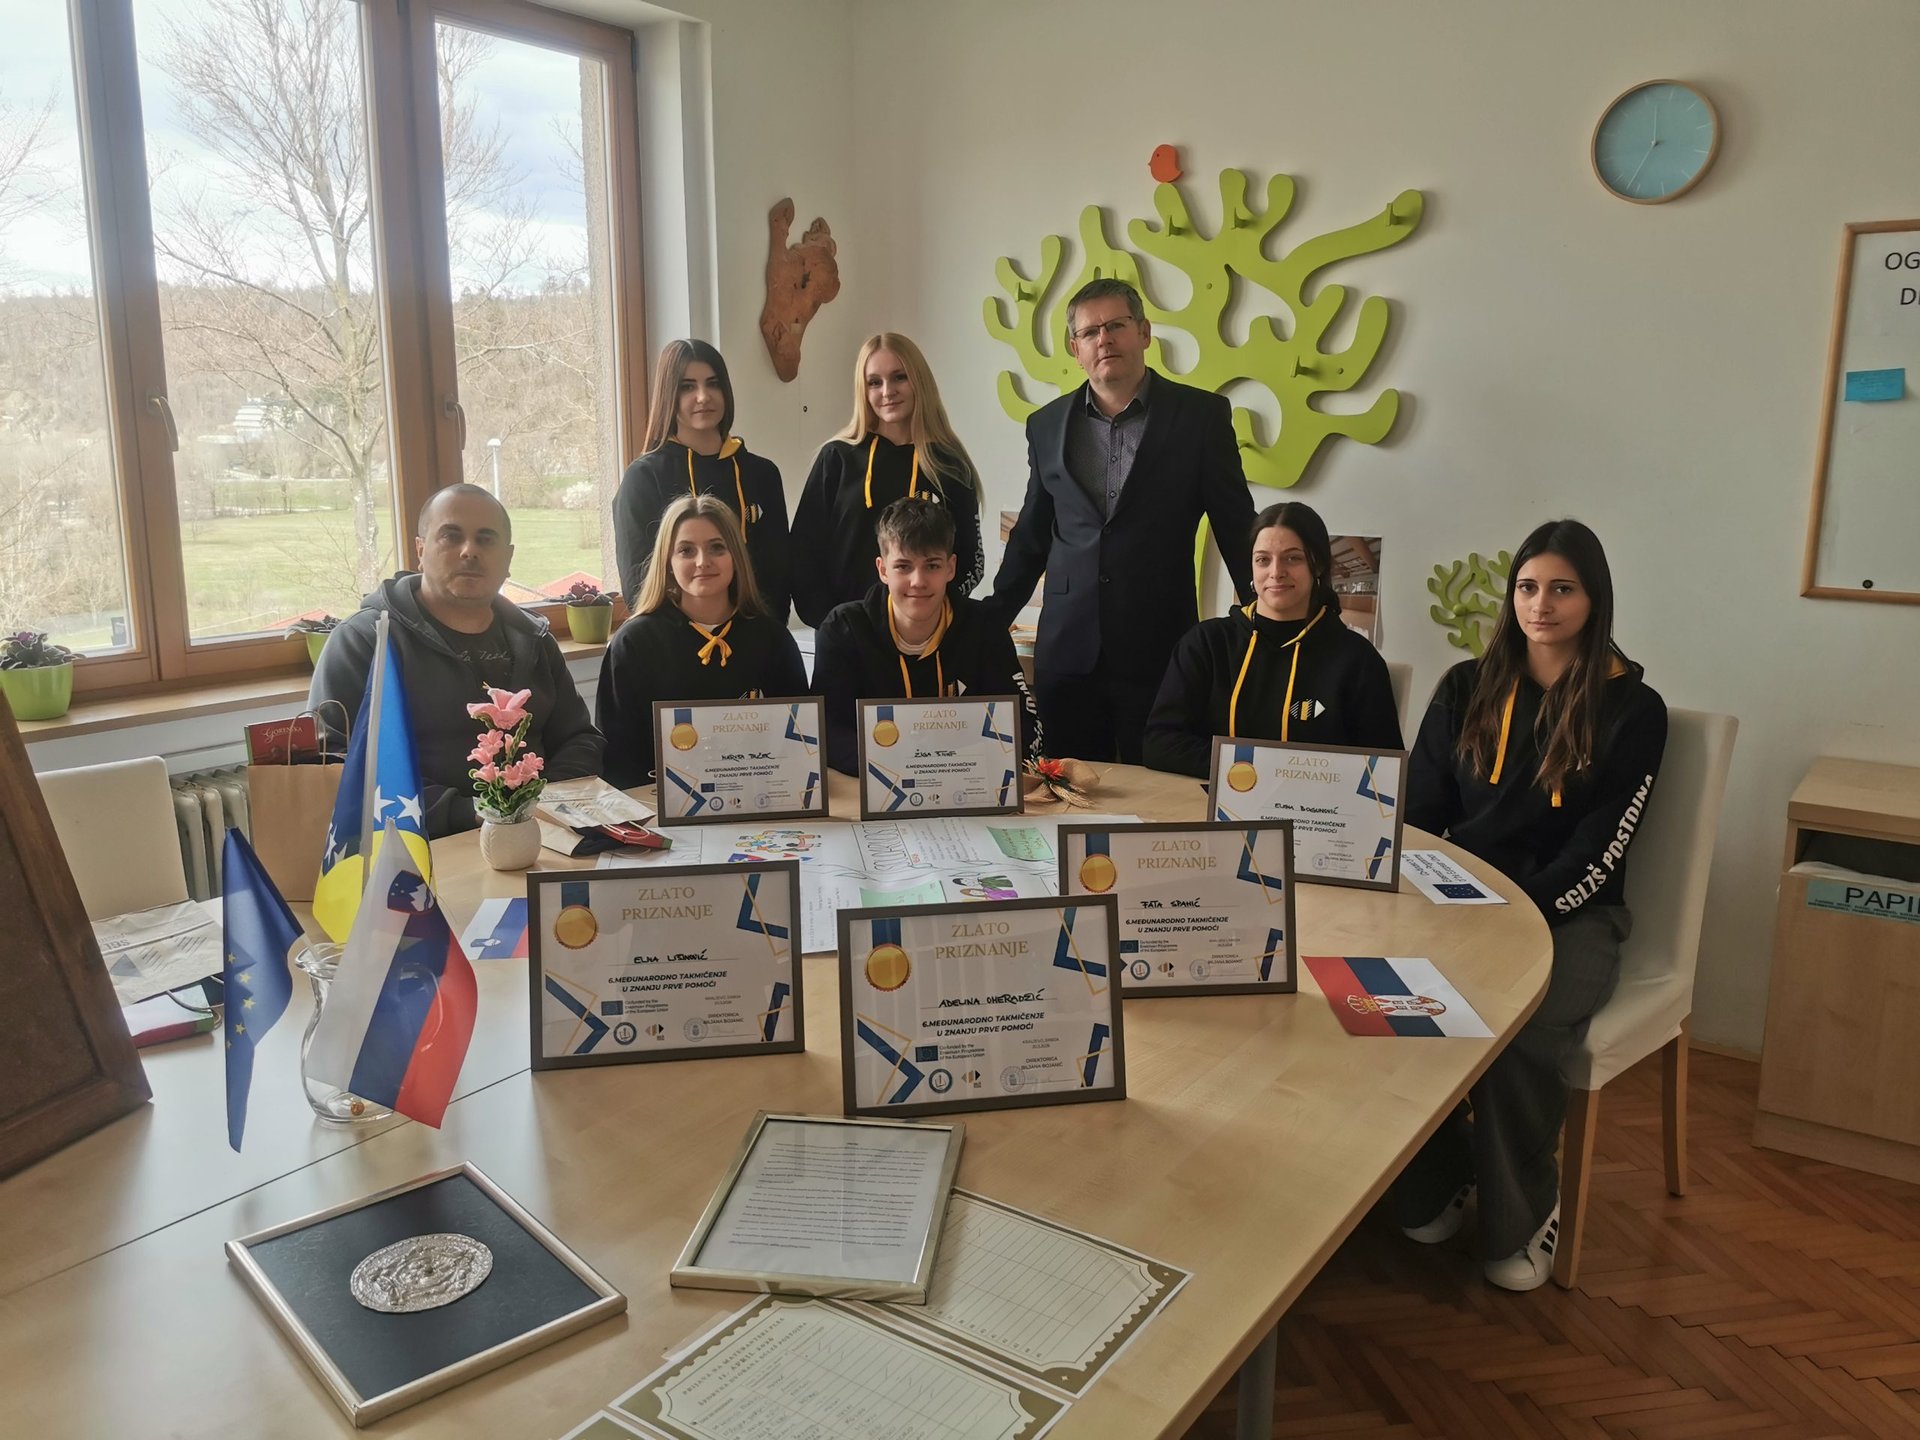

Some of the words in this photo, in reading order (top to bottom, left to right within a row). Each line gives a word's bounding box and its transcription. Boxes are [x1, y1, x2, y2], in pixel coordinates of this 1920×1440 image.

[1900, 287, 1920, 306] D
[722, 712, 758, 720] ZLATO
[923, 710, 957, 719] ZLATO
[712, 722, 770, 734] PRIZNANJE
[913, 721, 968, 731] PRIZNANJE
[1288, 756, 1329, 767] ZLATO
[1275, 769, 1342, 784] PRIZNANJE
[1152, 840, 1201, 852] ZLATO
[1555, 863, 1607, 914] SGLZŠ
[1602, 774, 1653, 872] POSTOJNA
[1138, 856, 1217, 870] PRIZNANJE
[638, 886, 695, 901] ZLATO
[1845, 886, 1920, 914] PAPI
[622, 904, 714, 921] PRIZNANJE
[952, 922, 1010, 938] ZLATO
[936, 940, 1029, 959] PRIZNANJE
[938, 997, 981, 1009] ADELINA
[995, 1012, 1045, 1022] TAKMIČENJE
[944, 1027, 977, 1037] ZNANJU
[1001, 1022, 1034, 1032] POMOĆI
